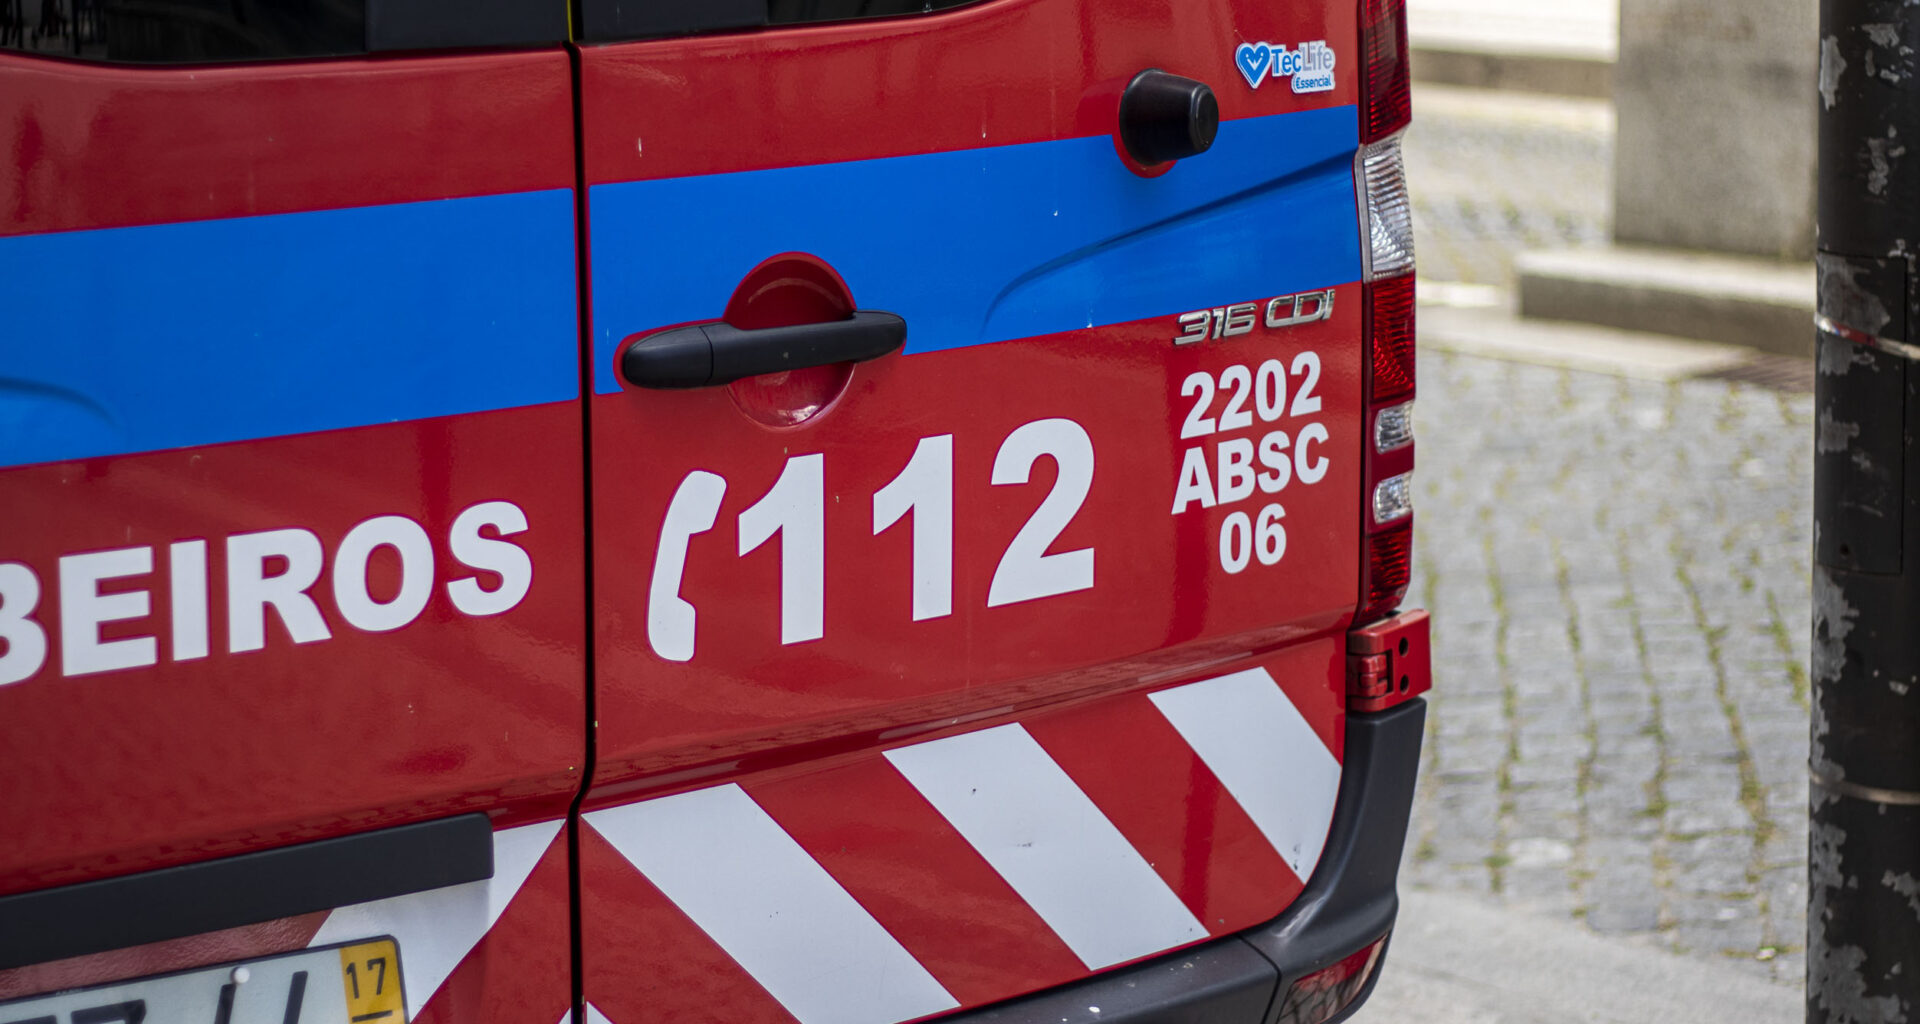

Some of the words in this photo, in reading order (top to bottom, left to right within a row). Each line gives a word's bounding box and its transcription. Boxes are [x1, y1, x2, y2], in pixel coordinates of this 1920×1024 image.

[1271, 45, 1333, 74] TecLife
[1295, 74, 1332, 89] Essencial
[1173, 302, 1257, 345] 316
[1265, 289, 1336, 328] CDI
[1180, 351, 1322, 440] 2202
[1171, 422, 1330, 515] ABSC
[738, 418, 1095, 645] 112
[1219, 503, 1287, 574] 06
[346, 957, 386, 999] 17
